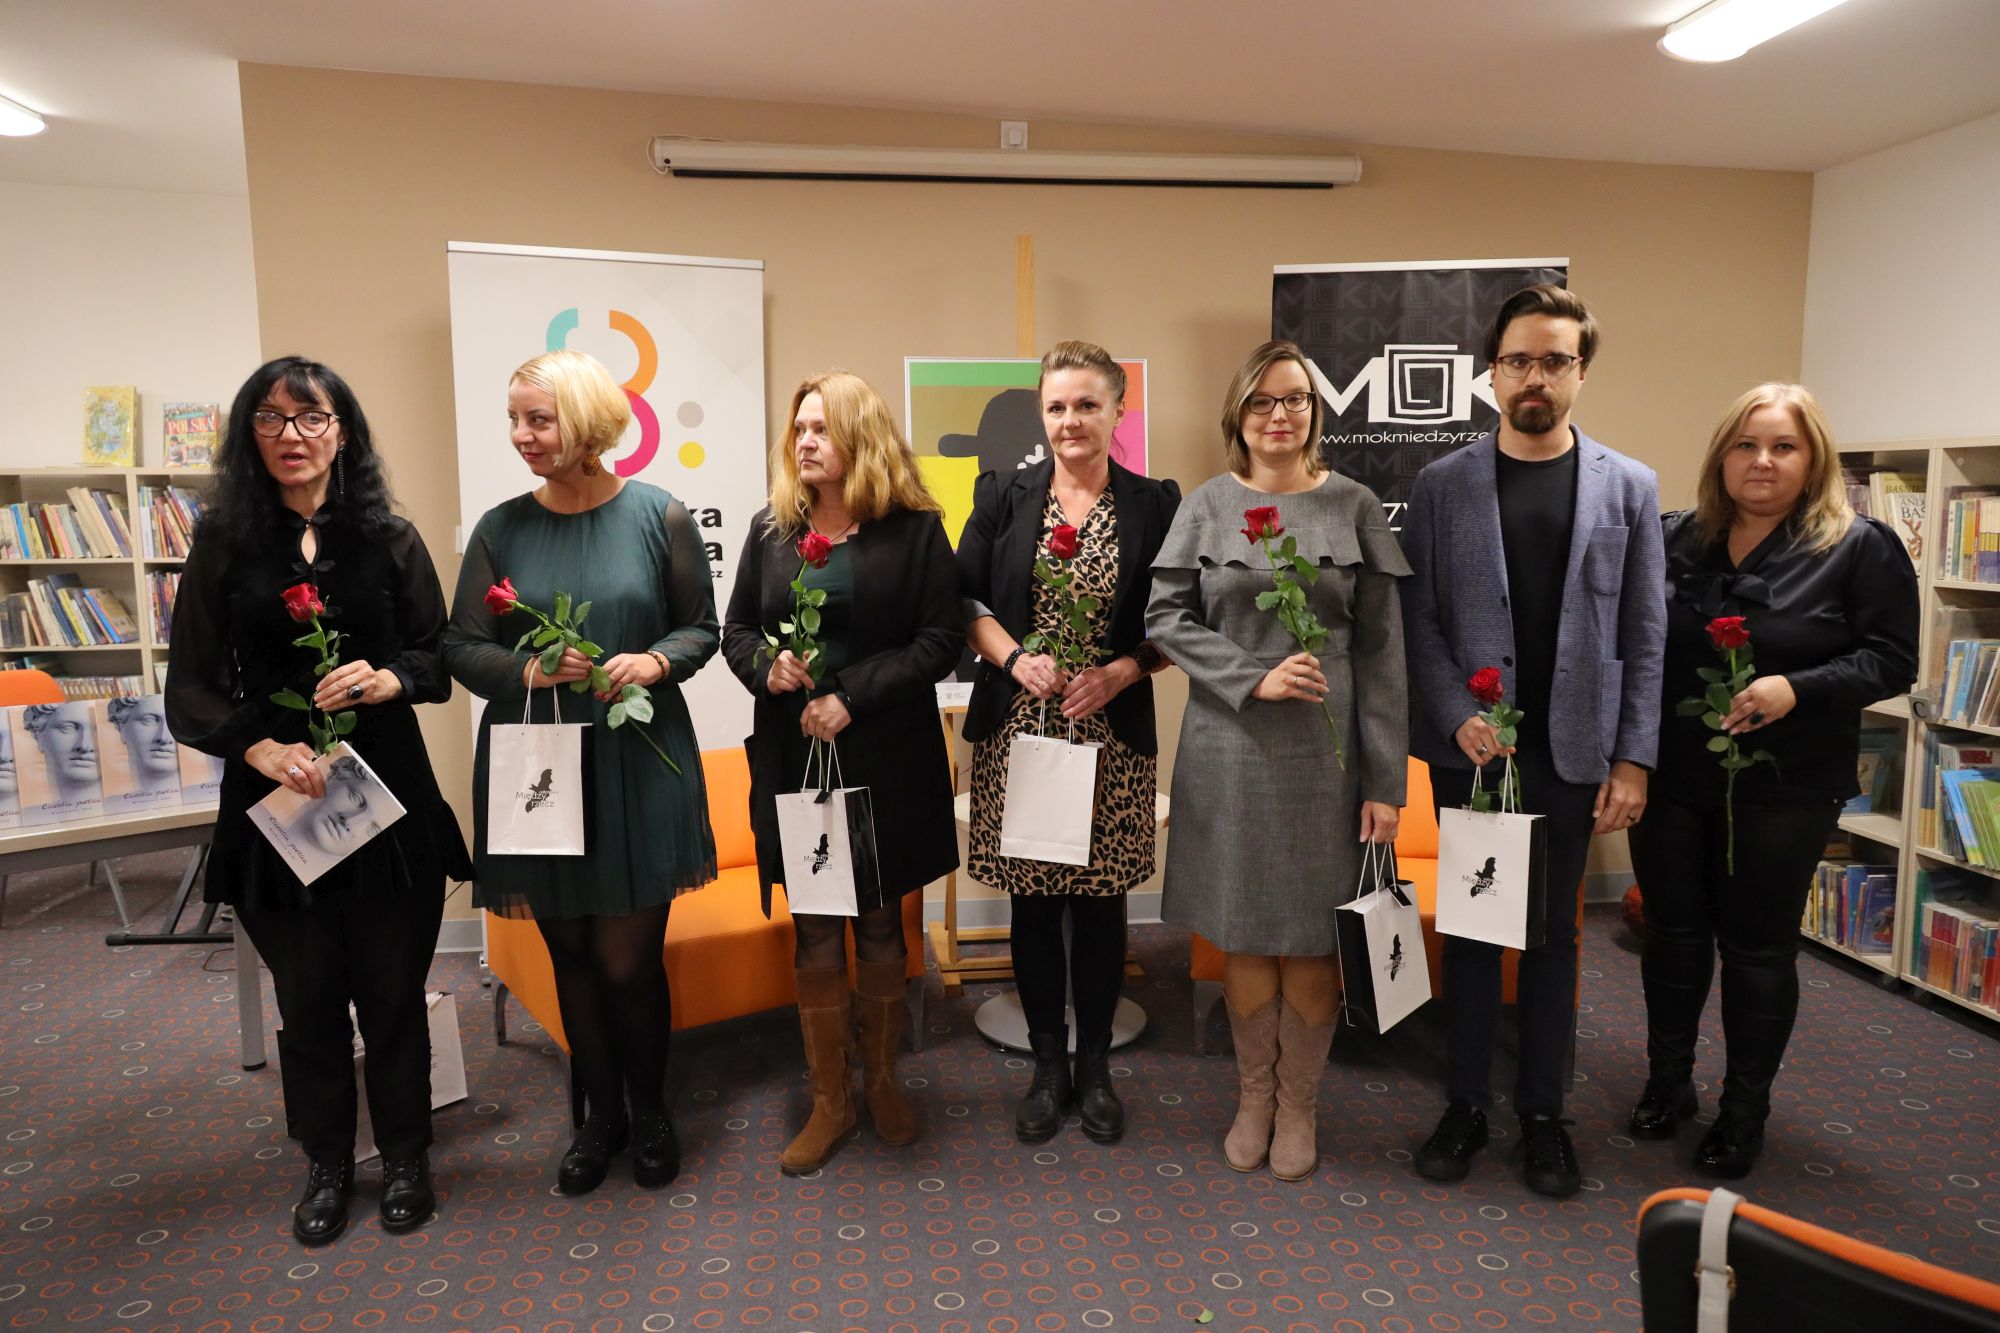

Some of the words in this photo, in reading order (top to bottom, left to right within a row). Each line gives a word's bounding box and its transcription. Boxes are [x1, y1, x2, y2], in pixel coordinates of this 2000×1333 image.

[1306, 344, 1501, 425] MOK
[1319, 429, 1489, 445] ww.mokmiedzyrze
[704, 541, 724, 561] a
[709, 570, 723, 578] cz
[1912, 701, 1927, 719] C
